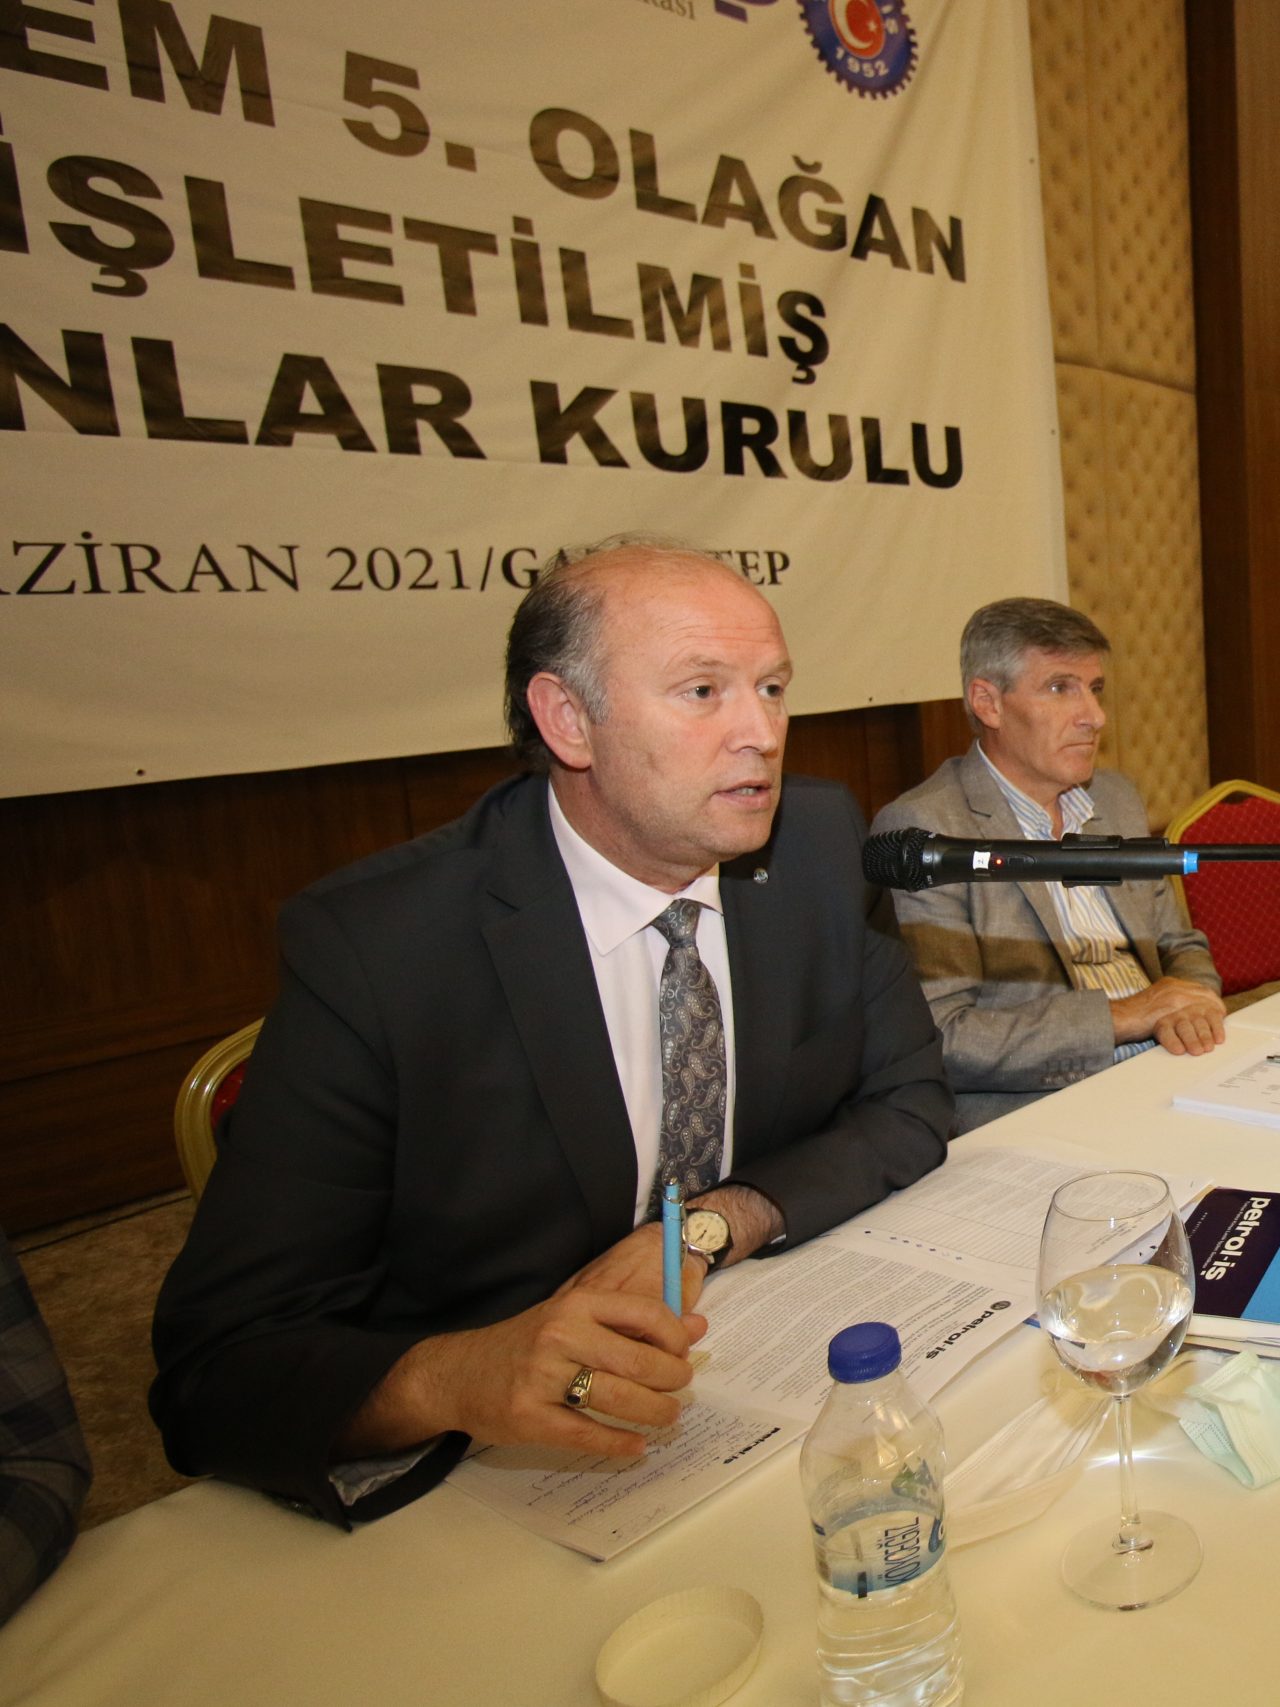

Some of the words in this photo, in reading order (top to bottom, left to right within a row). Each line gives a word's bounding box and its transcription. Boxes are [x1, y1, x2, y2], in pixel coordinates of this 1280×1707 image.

[835, 46, 889, 78] 1952
[341, 50, 478, 173] 5.
[527, 106, 968, 284] OLAĞAN
[0, 322, 487, 460] NLAR
[529, 380, 964, 489] KURULU
[0, 531, 300, 596] ZİRAN
